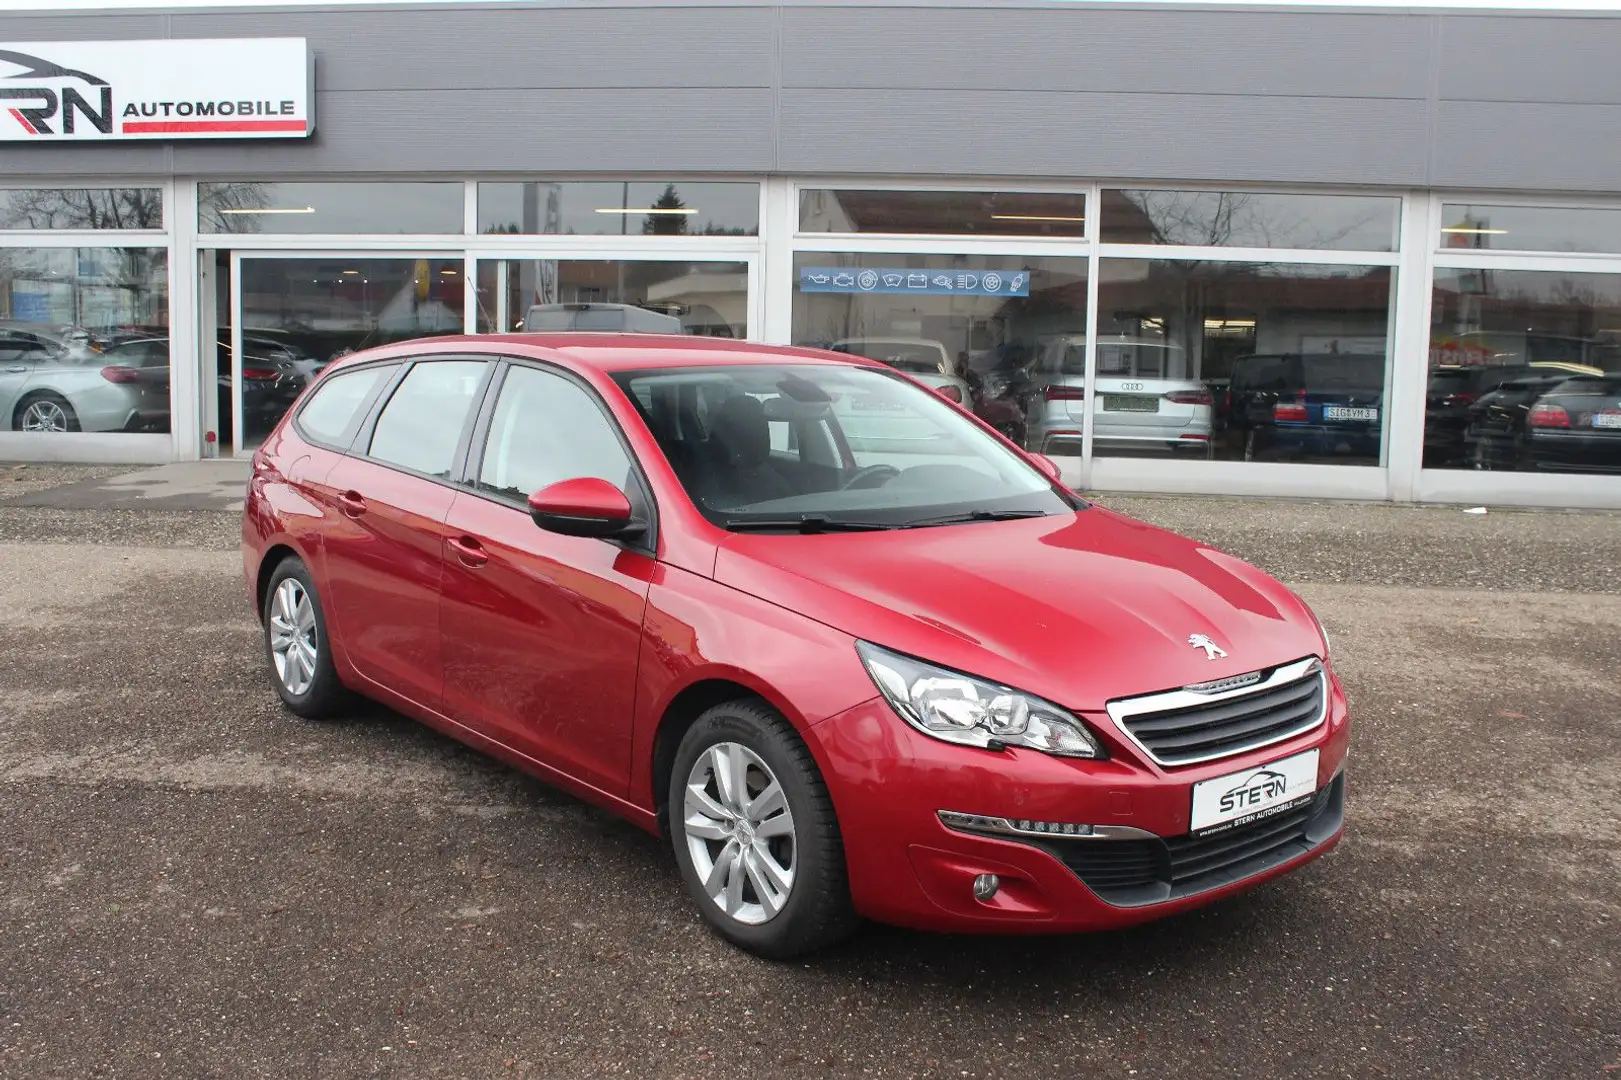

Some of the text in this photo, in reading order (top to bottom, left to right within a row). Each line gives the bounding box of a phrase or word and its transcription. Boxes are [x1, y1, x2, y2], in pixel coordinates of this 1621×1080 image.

[122, 100, 295, 117] AUTOMOBILE
[1219, 777, 1287, 813] STERN
[1234, 814, 1256, 827] STERN
[1256, 801, 1294, 820] AUTOMOBILE
